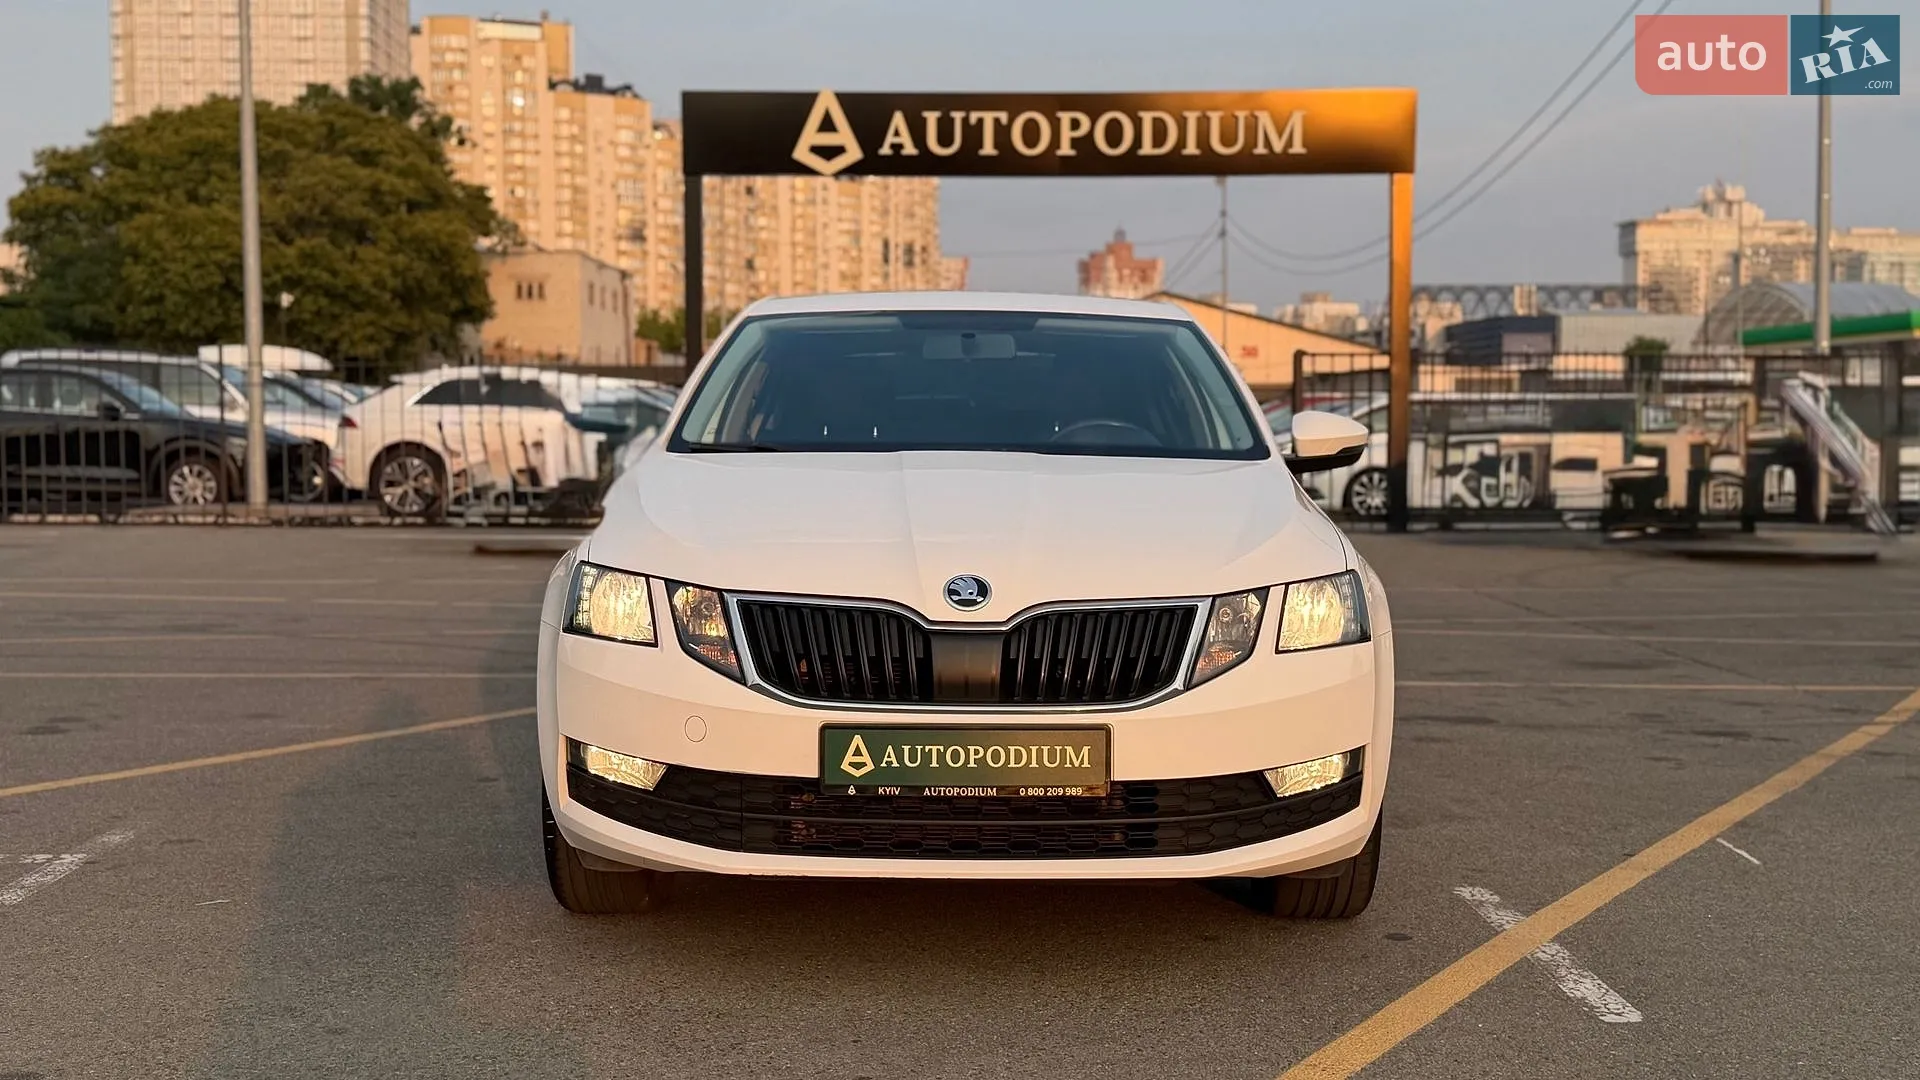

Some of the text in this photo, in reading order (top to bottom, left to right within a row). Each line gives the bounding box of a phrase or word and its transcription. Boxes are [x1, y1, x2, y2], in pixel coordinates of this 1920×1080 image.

[878, 110, 1308, 156] AUTOPODIUM
[879, 744, 1092, 769] AUTOPODIUM
[878, 786, 1083, 797] KYIV AUTOPODIUM 0 800 209 989
